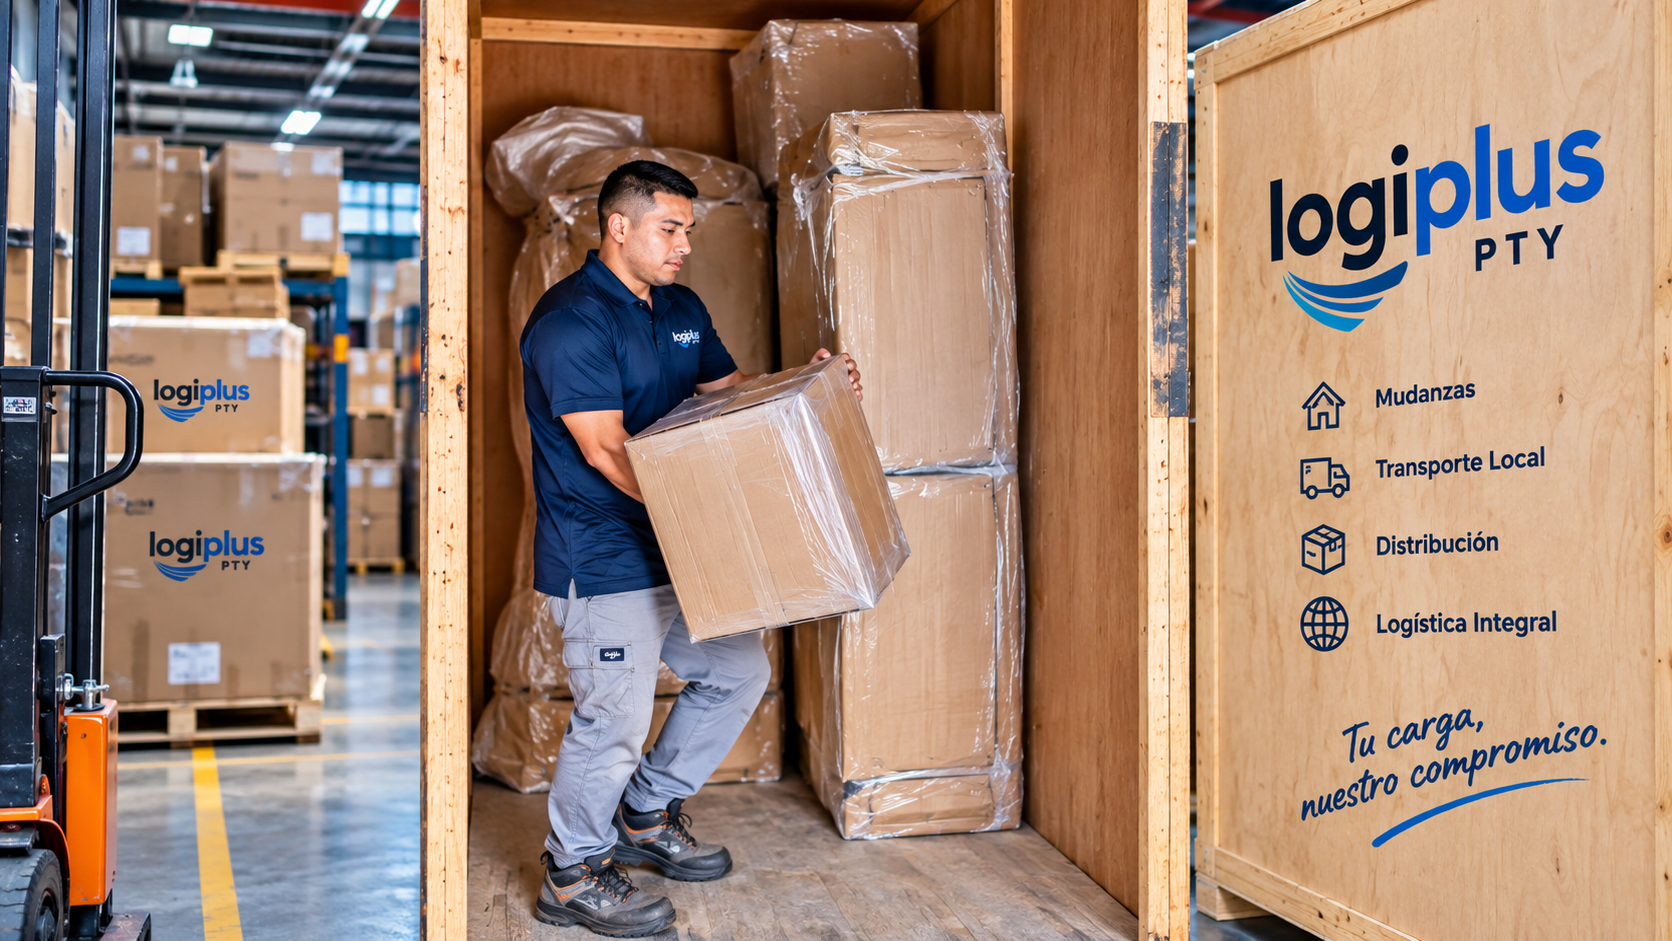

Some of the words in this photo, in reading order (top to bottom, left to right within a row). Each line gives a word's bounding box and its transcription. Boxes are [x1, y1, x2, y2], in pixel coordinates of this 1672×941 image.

[1270, 123, 1605, 271] logiplus
[1475, 224, 1564, 272] PTY
[153, 378, 250, 407] logiplus
[1375, 383, 1476, 408] Mudanzas
[215, 404, 239, 413] PTY
[1375, 454, 1483, 480] Transporte
[1489, 446, 1545, 470] Local
[149, 529, 265, 564] logiplus
[1376, 531, 1499, 556] Distribución
[221, 560, 251, 571] PTY
[1376, 612, 1467, 638] Logística
[1474, 610, 1557, 638] Integral
[1342, 721, 1376, 763] Tu
[1387, 708, 1484, 751] carga,
[1301, 769, 1398, 821] nuestro
[1410, 721, 1607, 787] compromiso.
